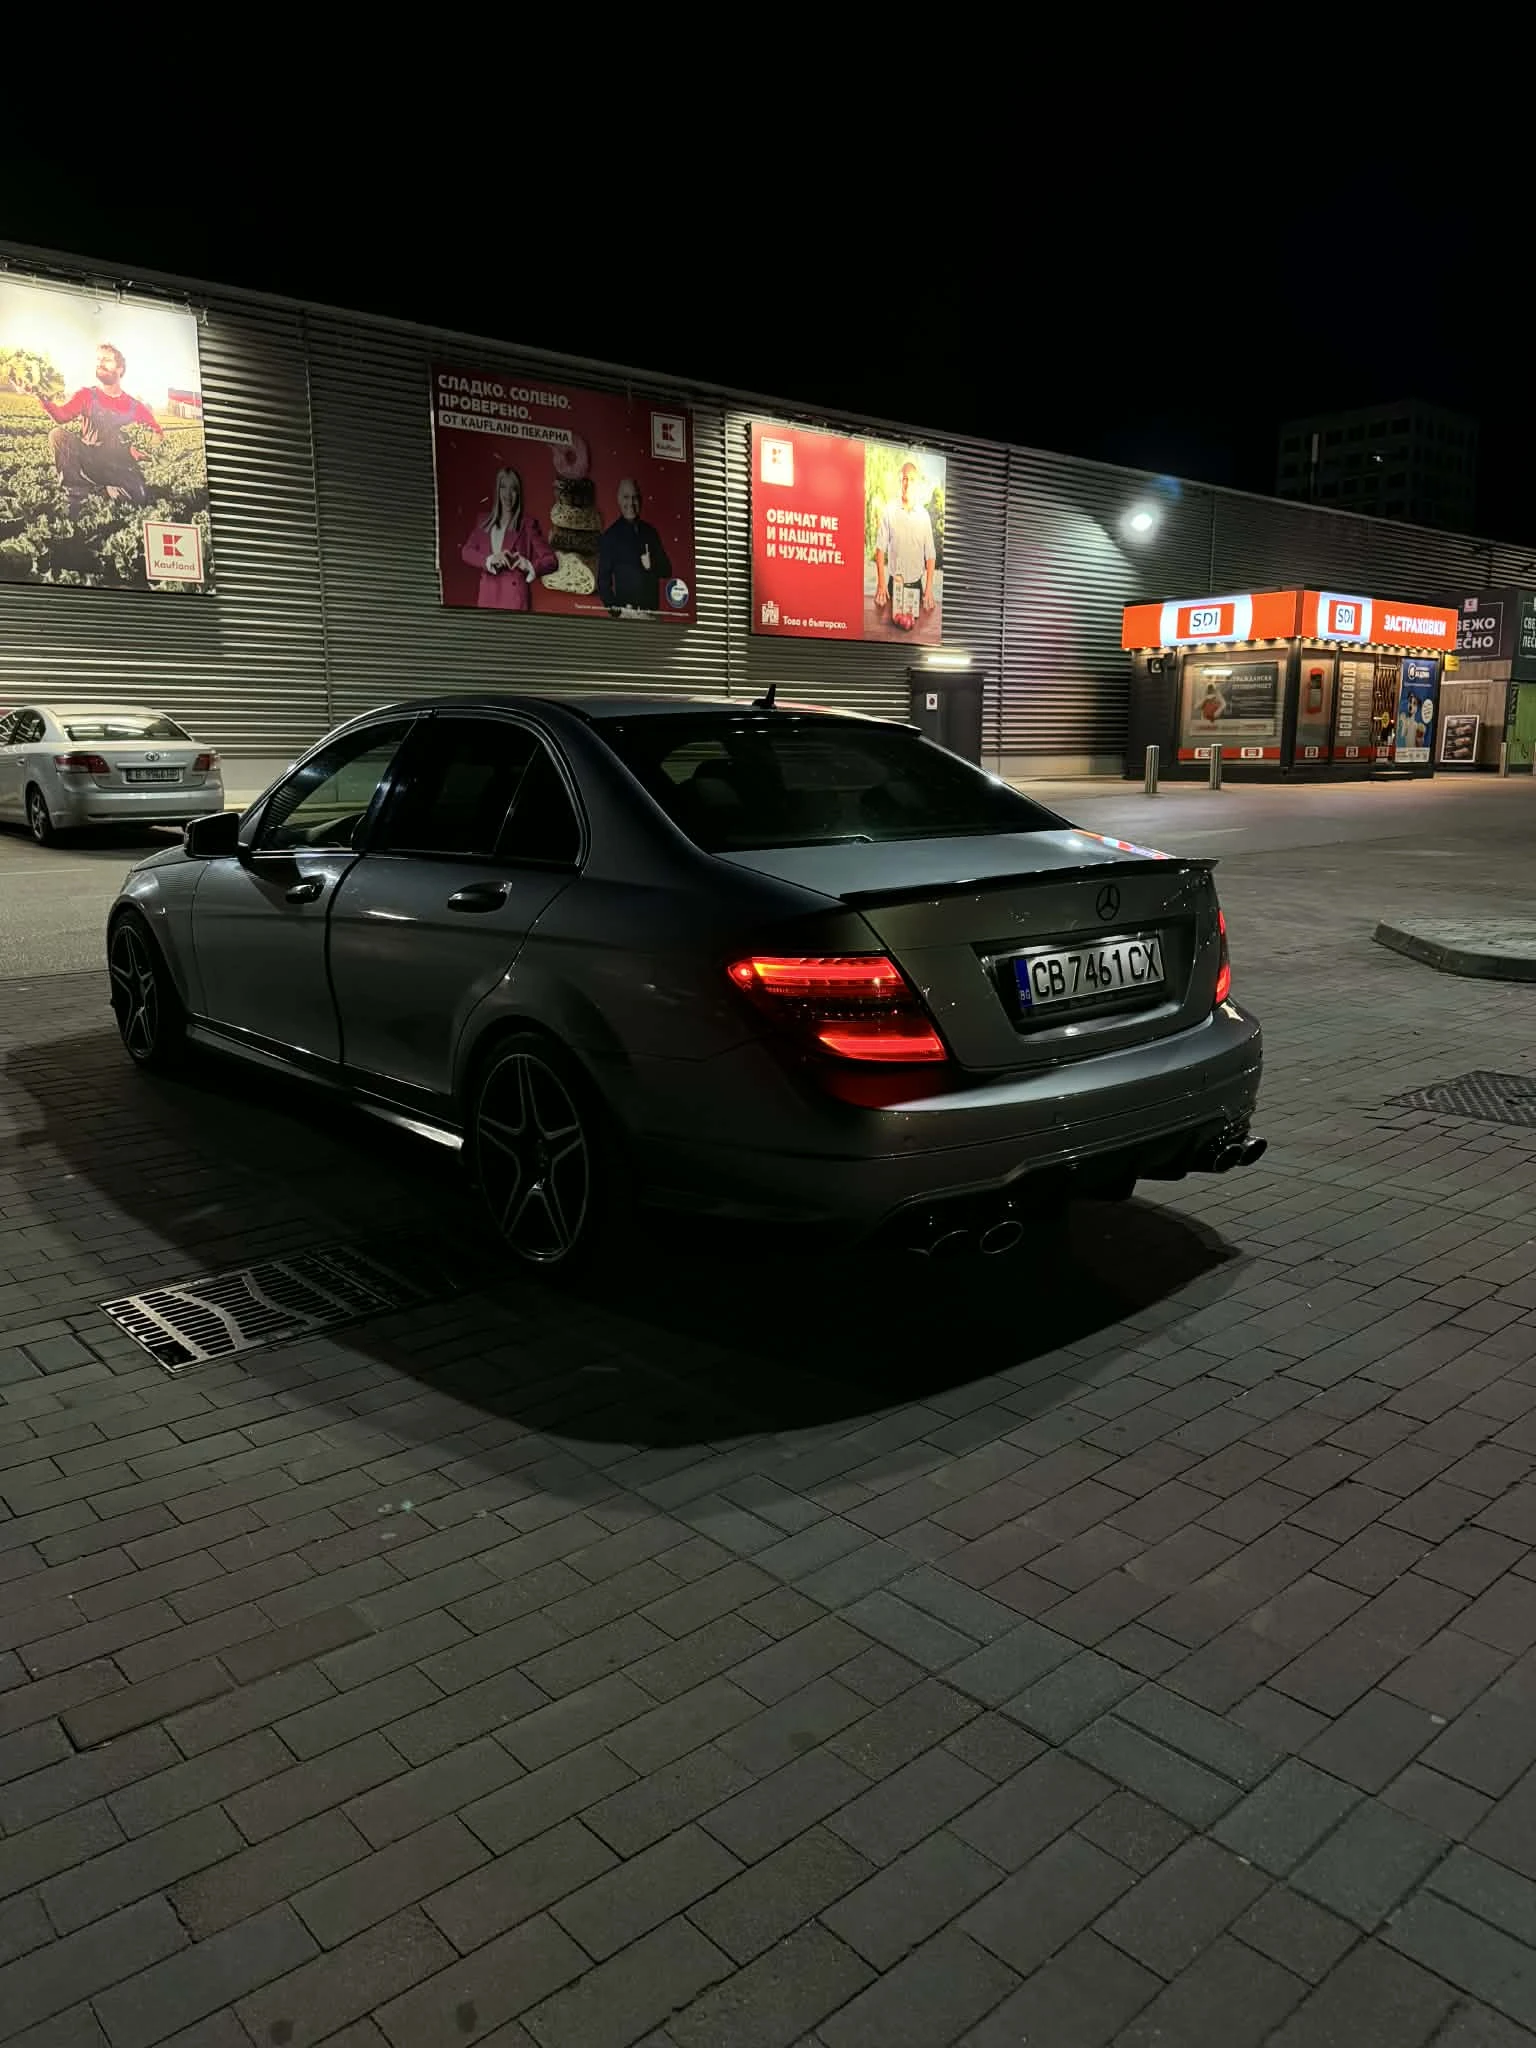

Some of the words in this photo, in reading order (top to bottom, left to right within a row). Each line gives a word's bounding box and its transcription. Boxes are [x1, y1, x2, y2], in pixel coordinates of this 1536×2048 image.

[437, 374, 508, 399] СЛАДКО.
[509, 386, 572, 410] СОЛЕНО.
[438, 393, 532, 421] ПРОВЕРЕНО.
[442, 414, 457, 426] ОТ
[460, 416, 519, 435] KAUFLAND
[521, 426, 569, 443] ПЕКАРНА
[766, 508, 818, 529] ОБИЧАТ
[820, 515, 839, 531] МЕ
[766, 525, 776, 540] И
[778, 527, 836, 549] НАШИТЕ,
[766, 542, 776, 558] И
[778, 543, 845, 565] ЧУЖДИТЕ.
[154, 560, 196, 572] Kaufland
[782, 615, 801, 626] Това
[803, 619, 808, 627] е
[808, 617, 848, 631] българско.
[1192, 611, 1218, 628] SDI
[1337, 607, 1354, 625] SDI
[1383, 614, 1447, 637] ЗАСТРАХОВКИ
[1031, 959, 1066, 997] CB
[1068, 949, 1124, 993] 7461
[1128, 943, 1159, 980] CX
[1019, 989, 1031, 1001] BG
